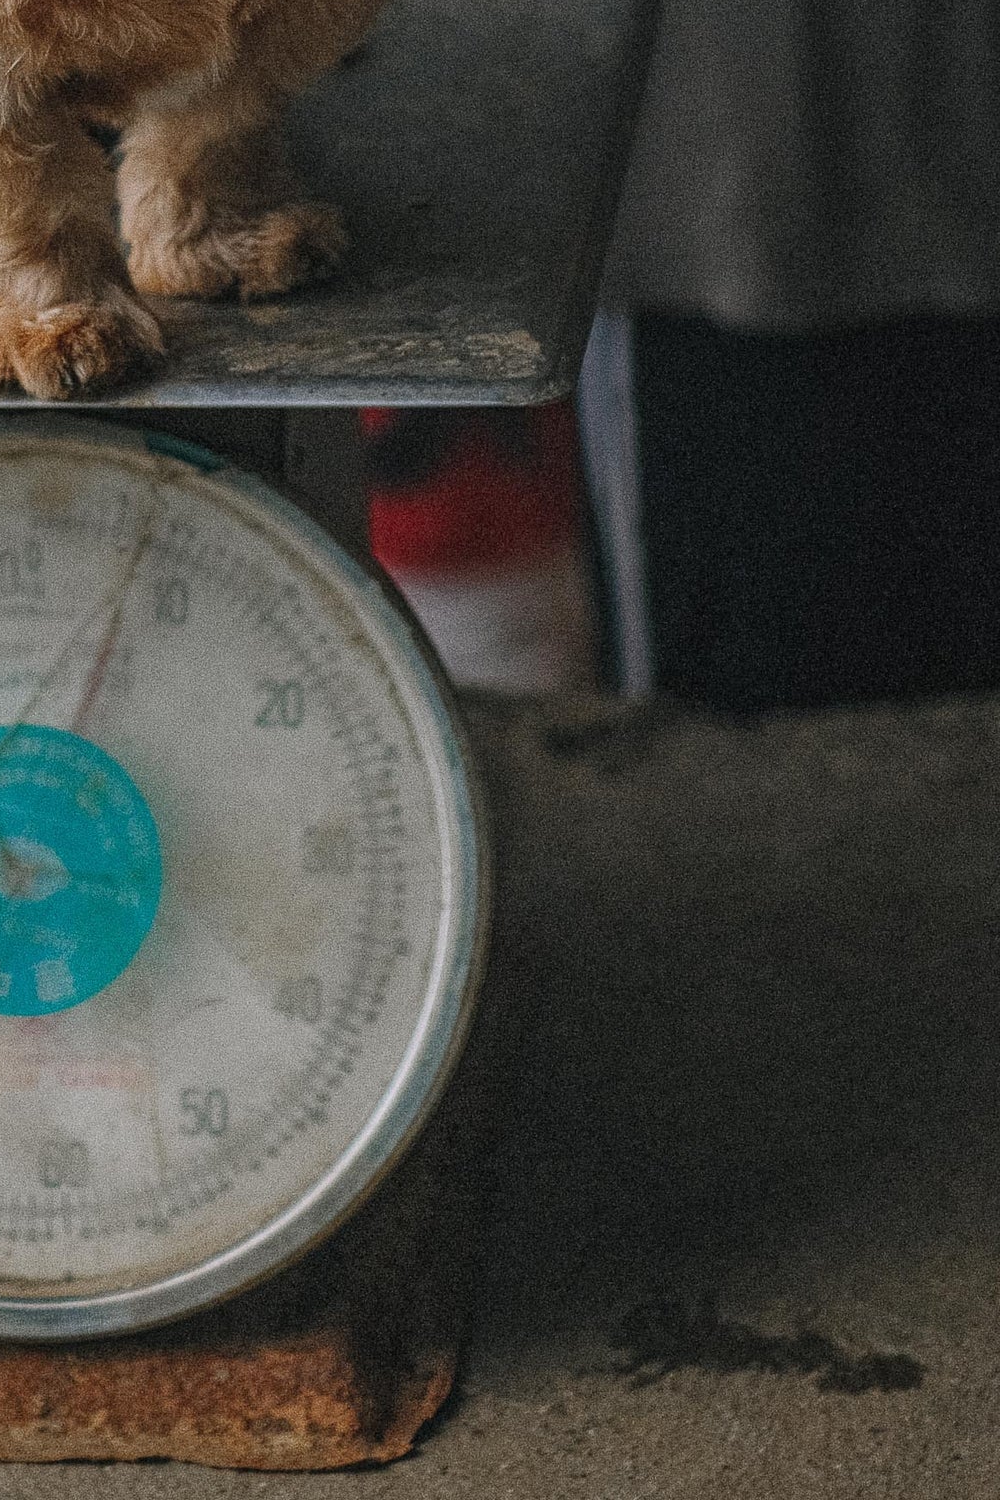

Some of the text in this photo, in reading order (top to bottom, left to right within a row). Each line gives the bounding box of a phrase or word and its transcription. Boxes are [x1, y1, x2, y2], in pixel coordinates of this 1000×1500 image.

[154, 576, 190, 627] 10
[254, 677, 305, 730] 20
[179, 1087, 230, 1138] 50
[37, 1139, 89, 1189] 60
